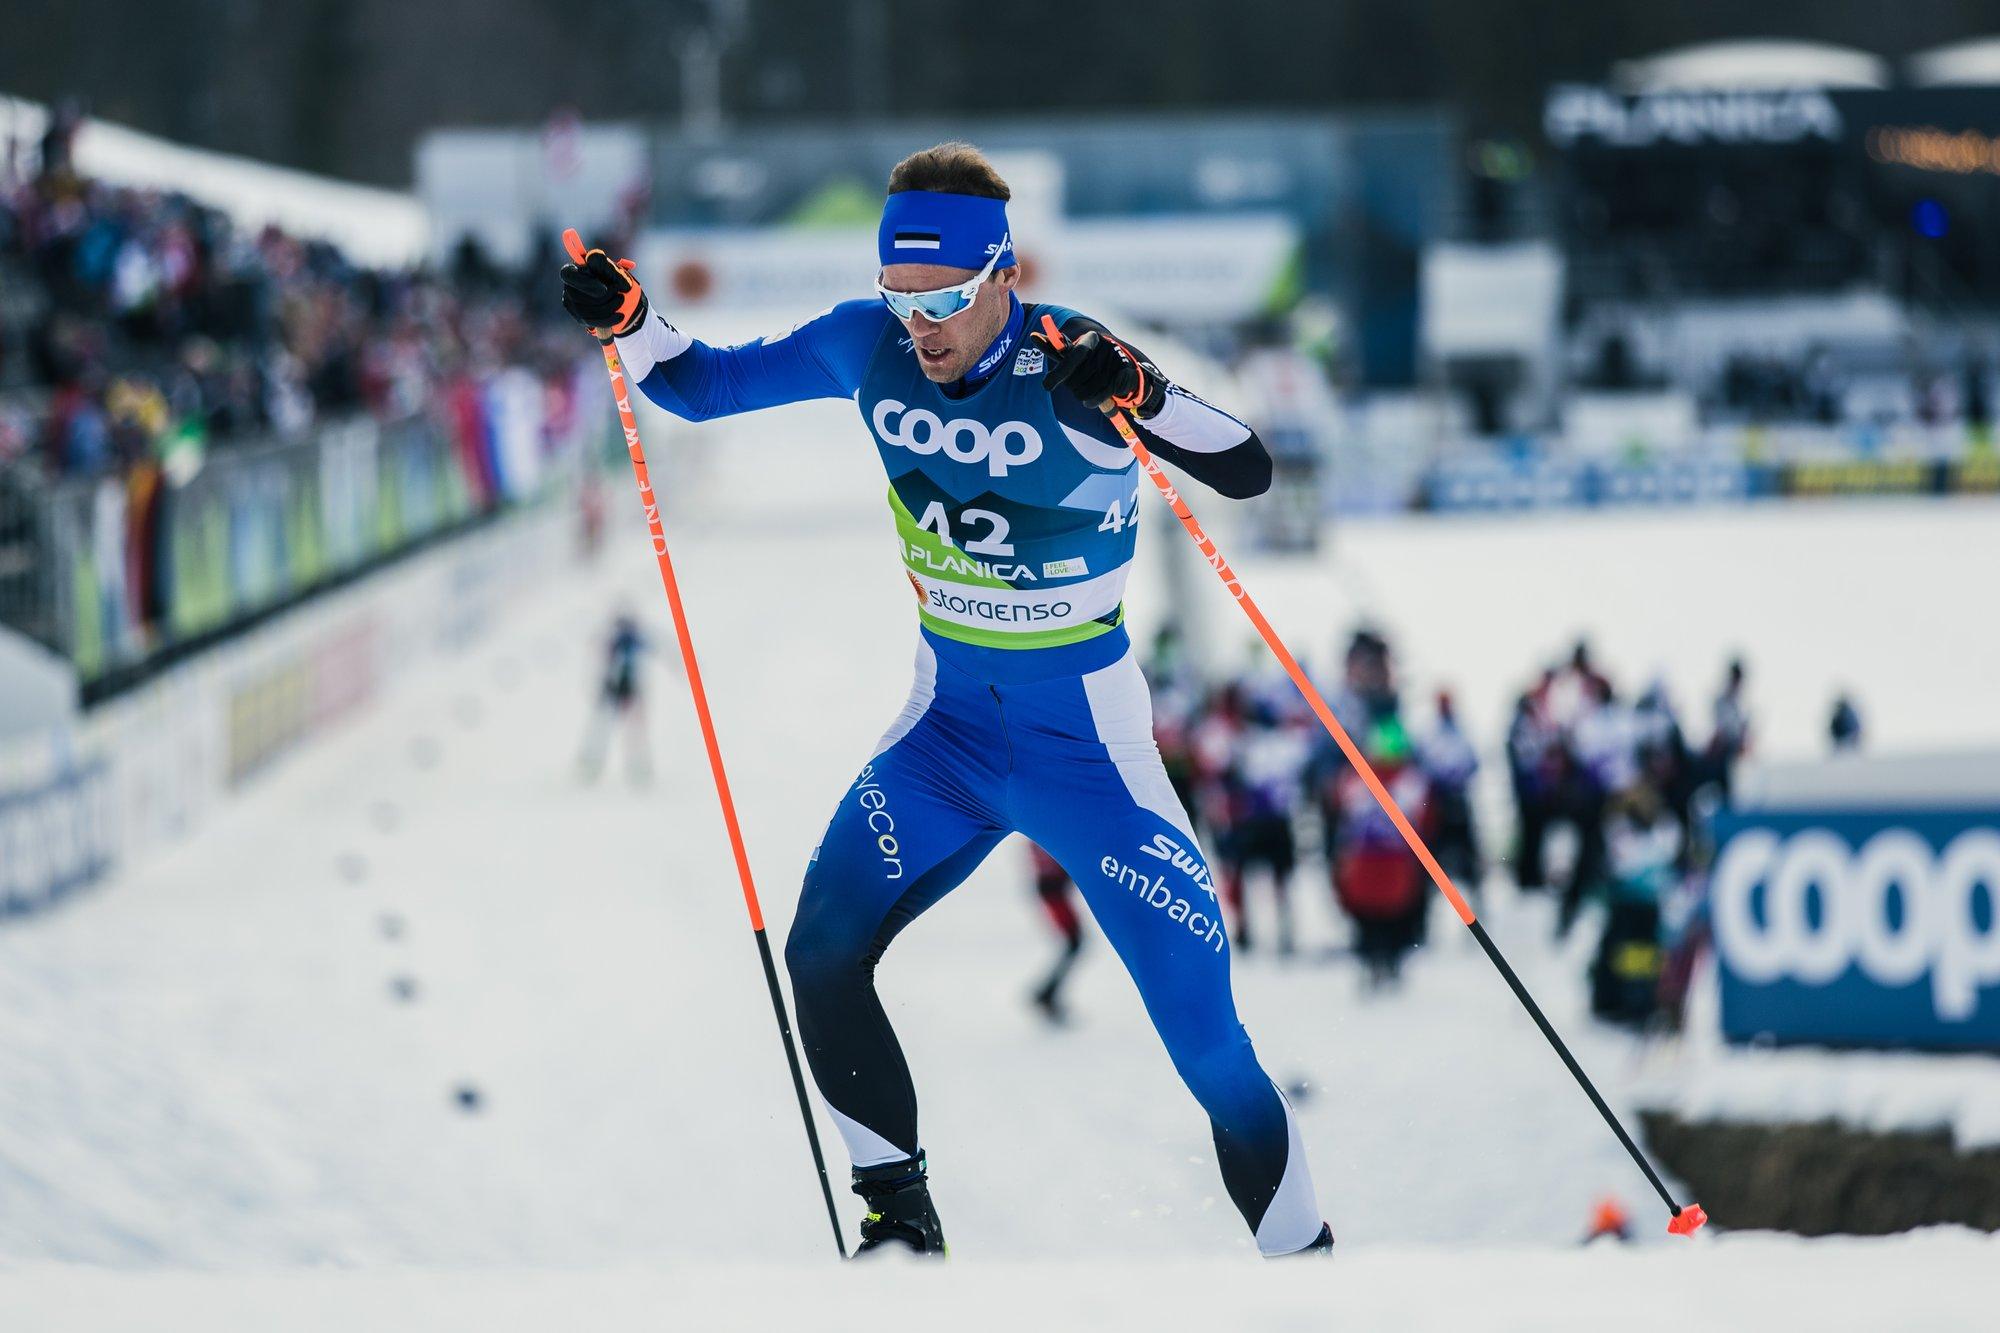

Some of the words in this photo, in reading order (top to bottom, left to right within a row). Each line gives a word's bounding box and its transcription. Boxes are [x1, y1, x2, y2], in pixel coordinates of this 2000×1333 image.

[979, 333, 1013, 374] Swix
[873, 399, 1043, 477] coop
[915, 500, 1015, 557] 42
[1097, 486, 1139, 534] 42
[910, 543, 1038, 581] PLANICA
[1139, 833, 1217, 903] Swix
[1100, 855, 1225, 953] embach
[1712, 827, 2000, 1022] coop
